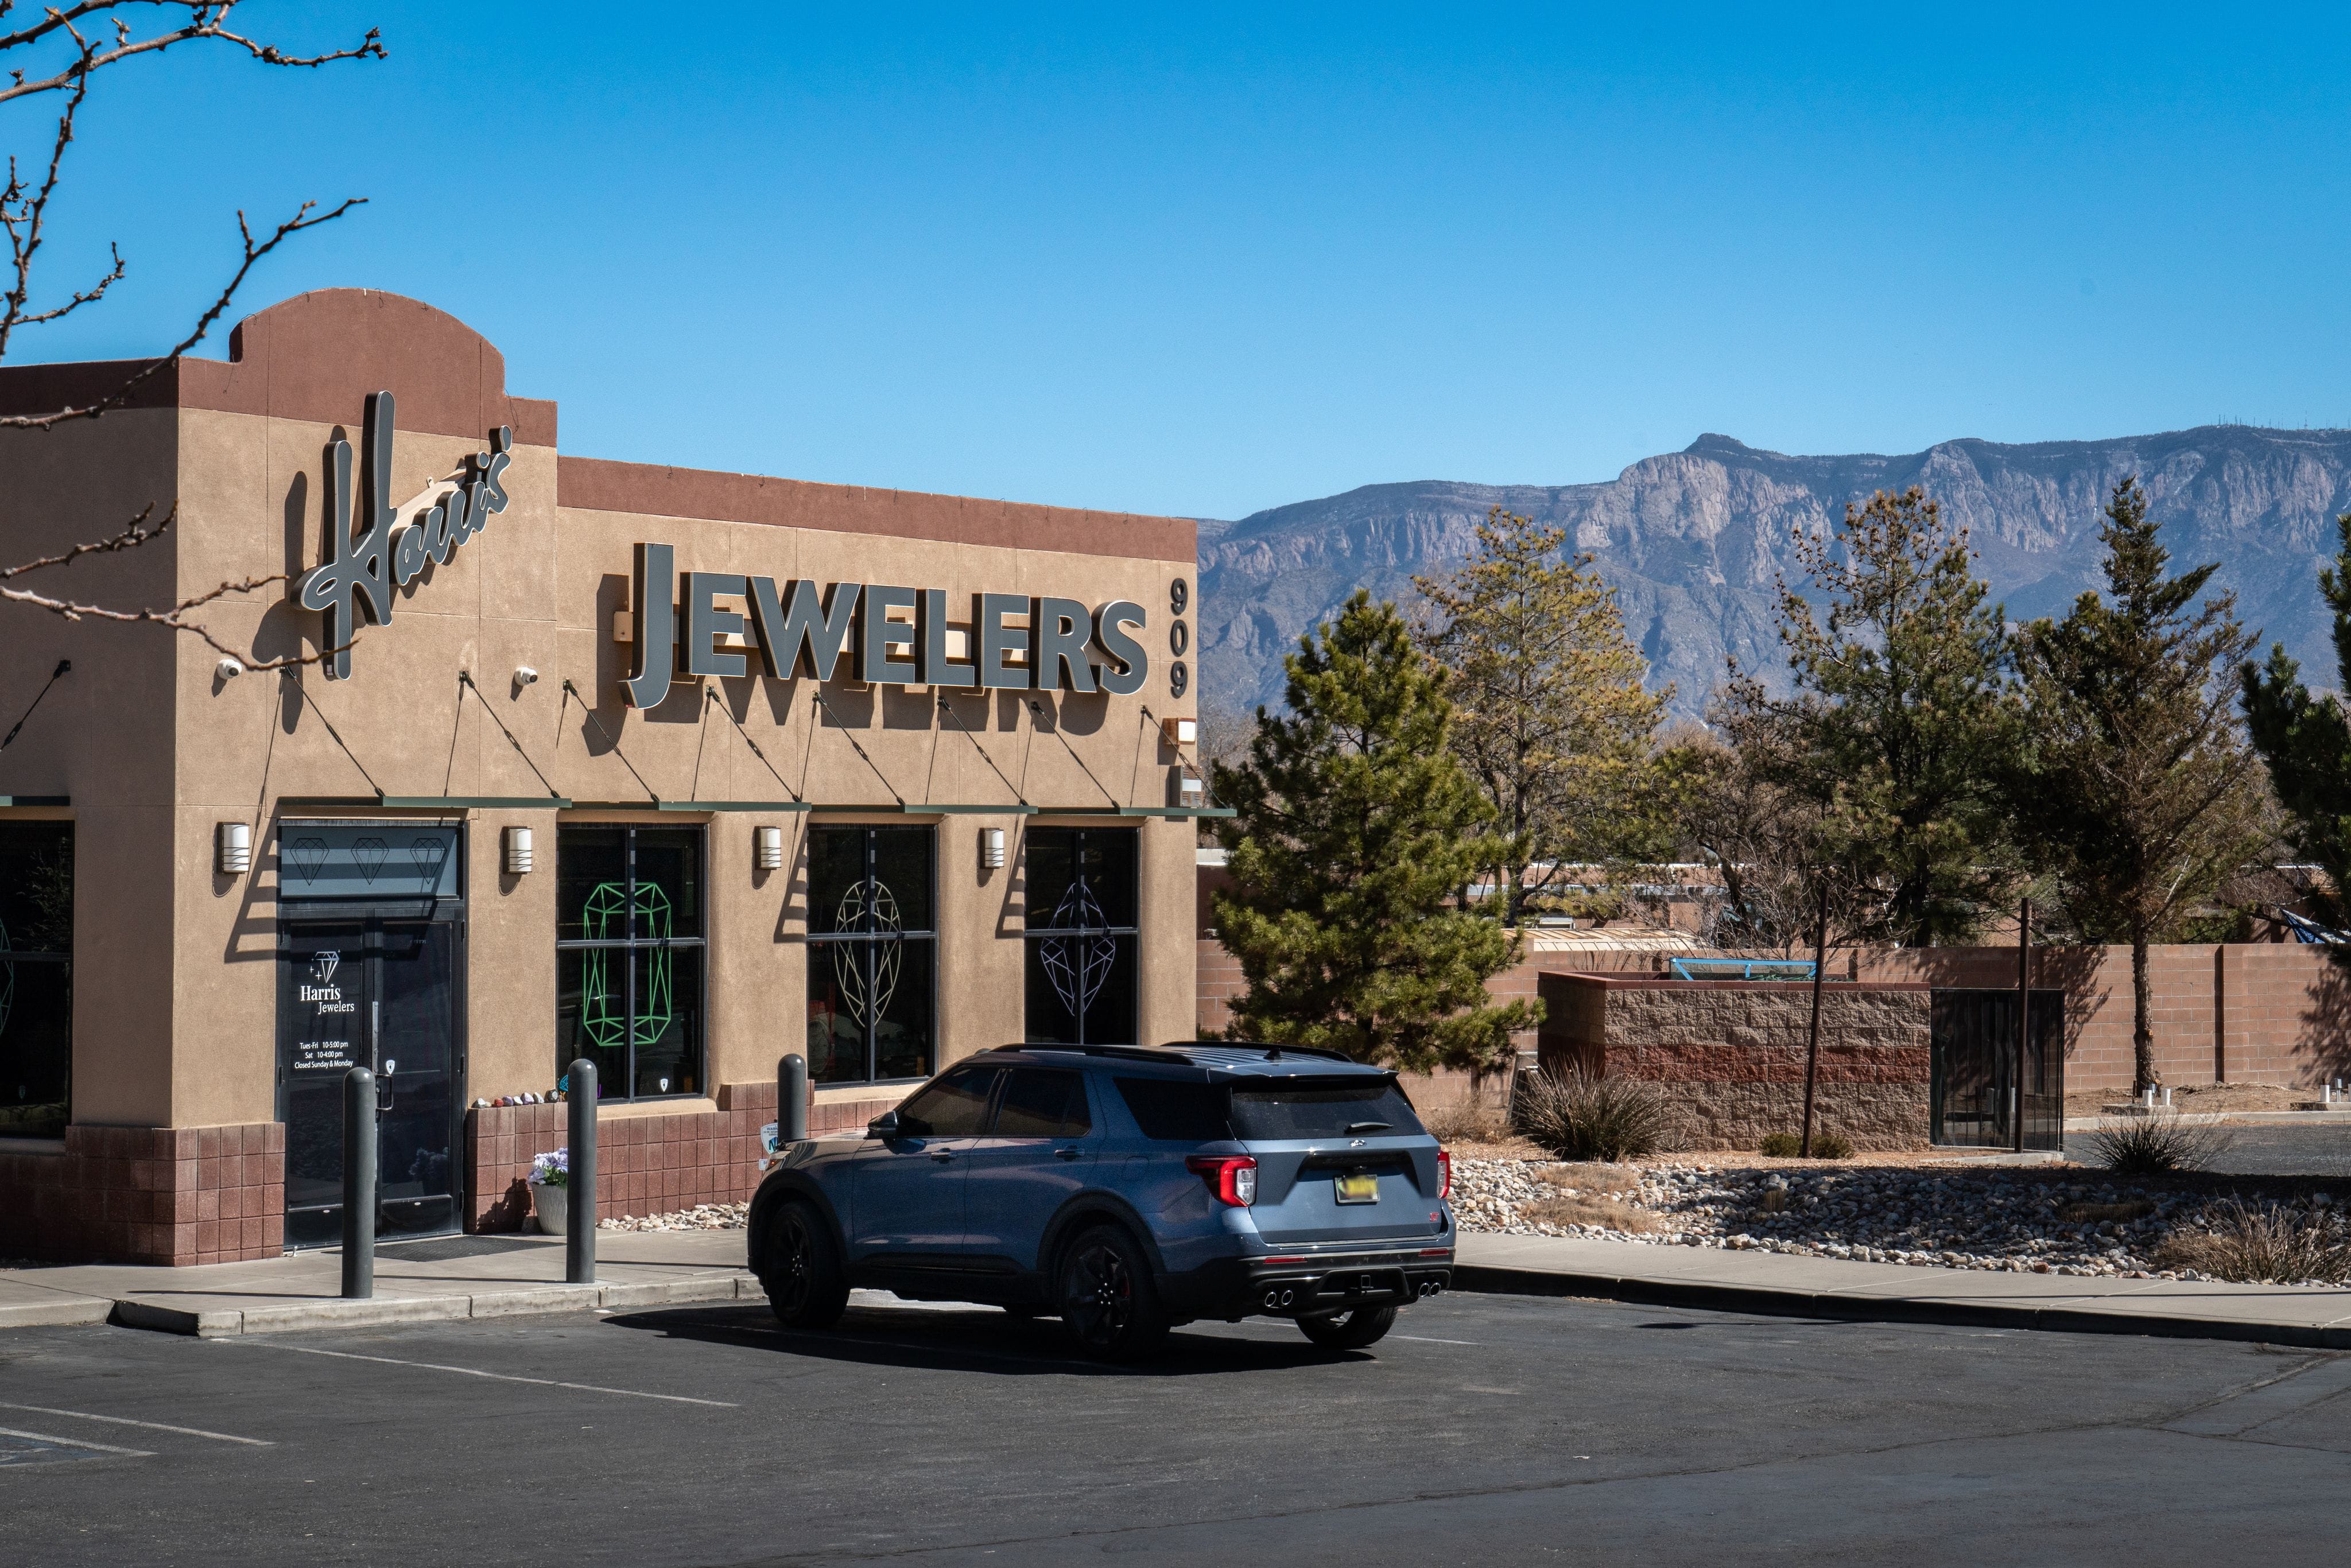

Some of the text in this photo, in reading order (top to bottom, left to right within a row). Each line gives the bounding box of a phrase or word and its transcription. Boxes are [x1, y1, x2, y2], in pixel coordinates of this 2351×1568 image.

[618, 542, 1147, 709] JEWELERS
[1169, 577, 1189, 698] 909
[300, 984, 340, 1001] Harris
[318, 1001, 354, 1015] Jewelers
[312, 1061, 329, 1069] Sunday
[334, 1059, 354, 1068] Monday
[1429, 1212, 1440, 1221] ST
